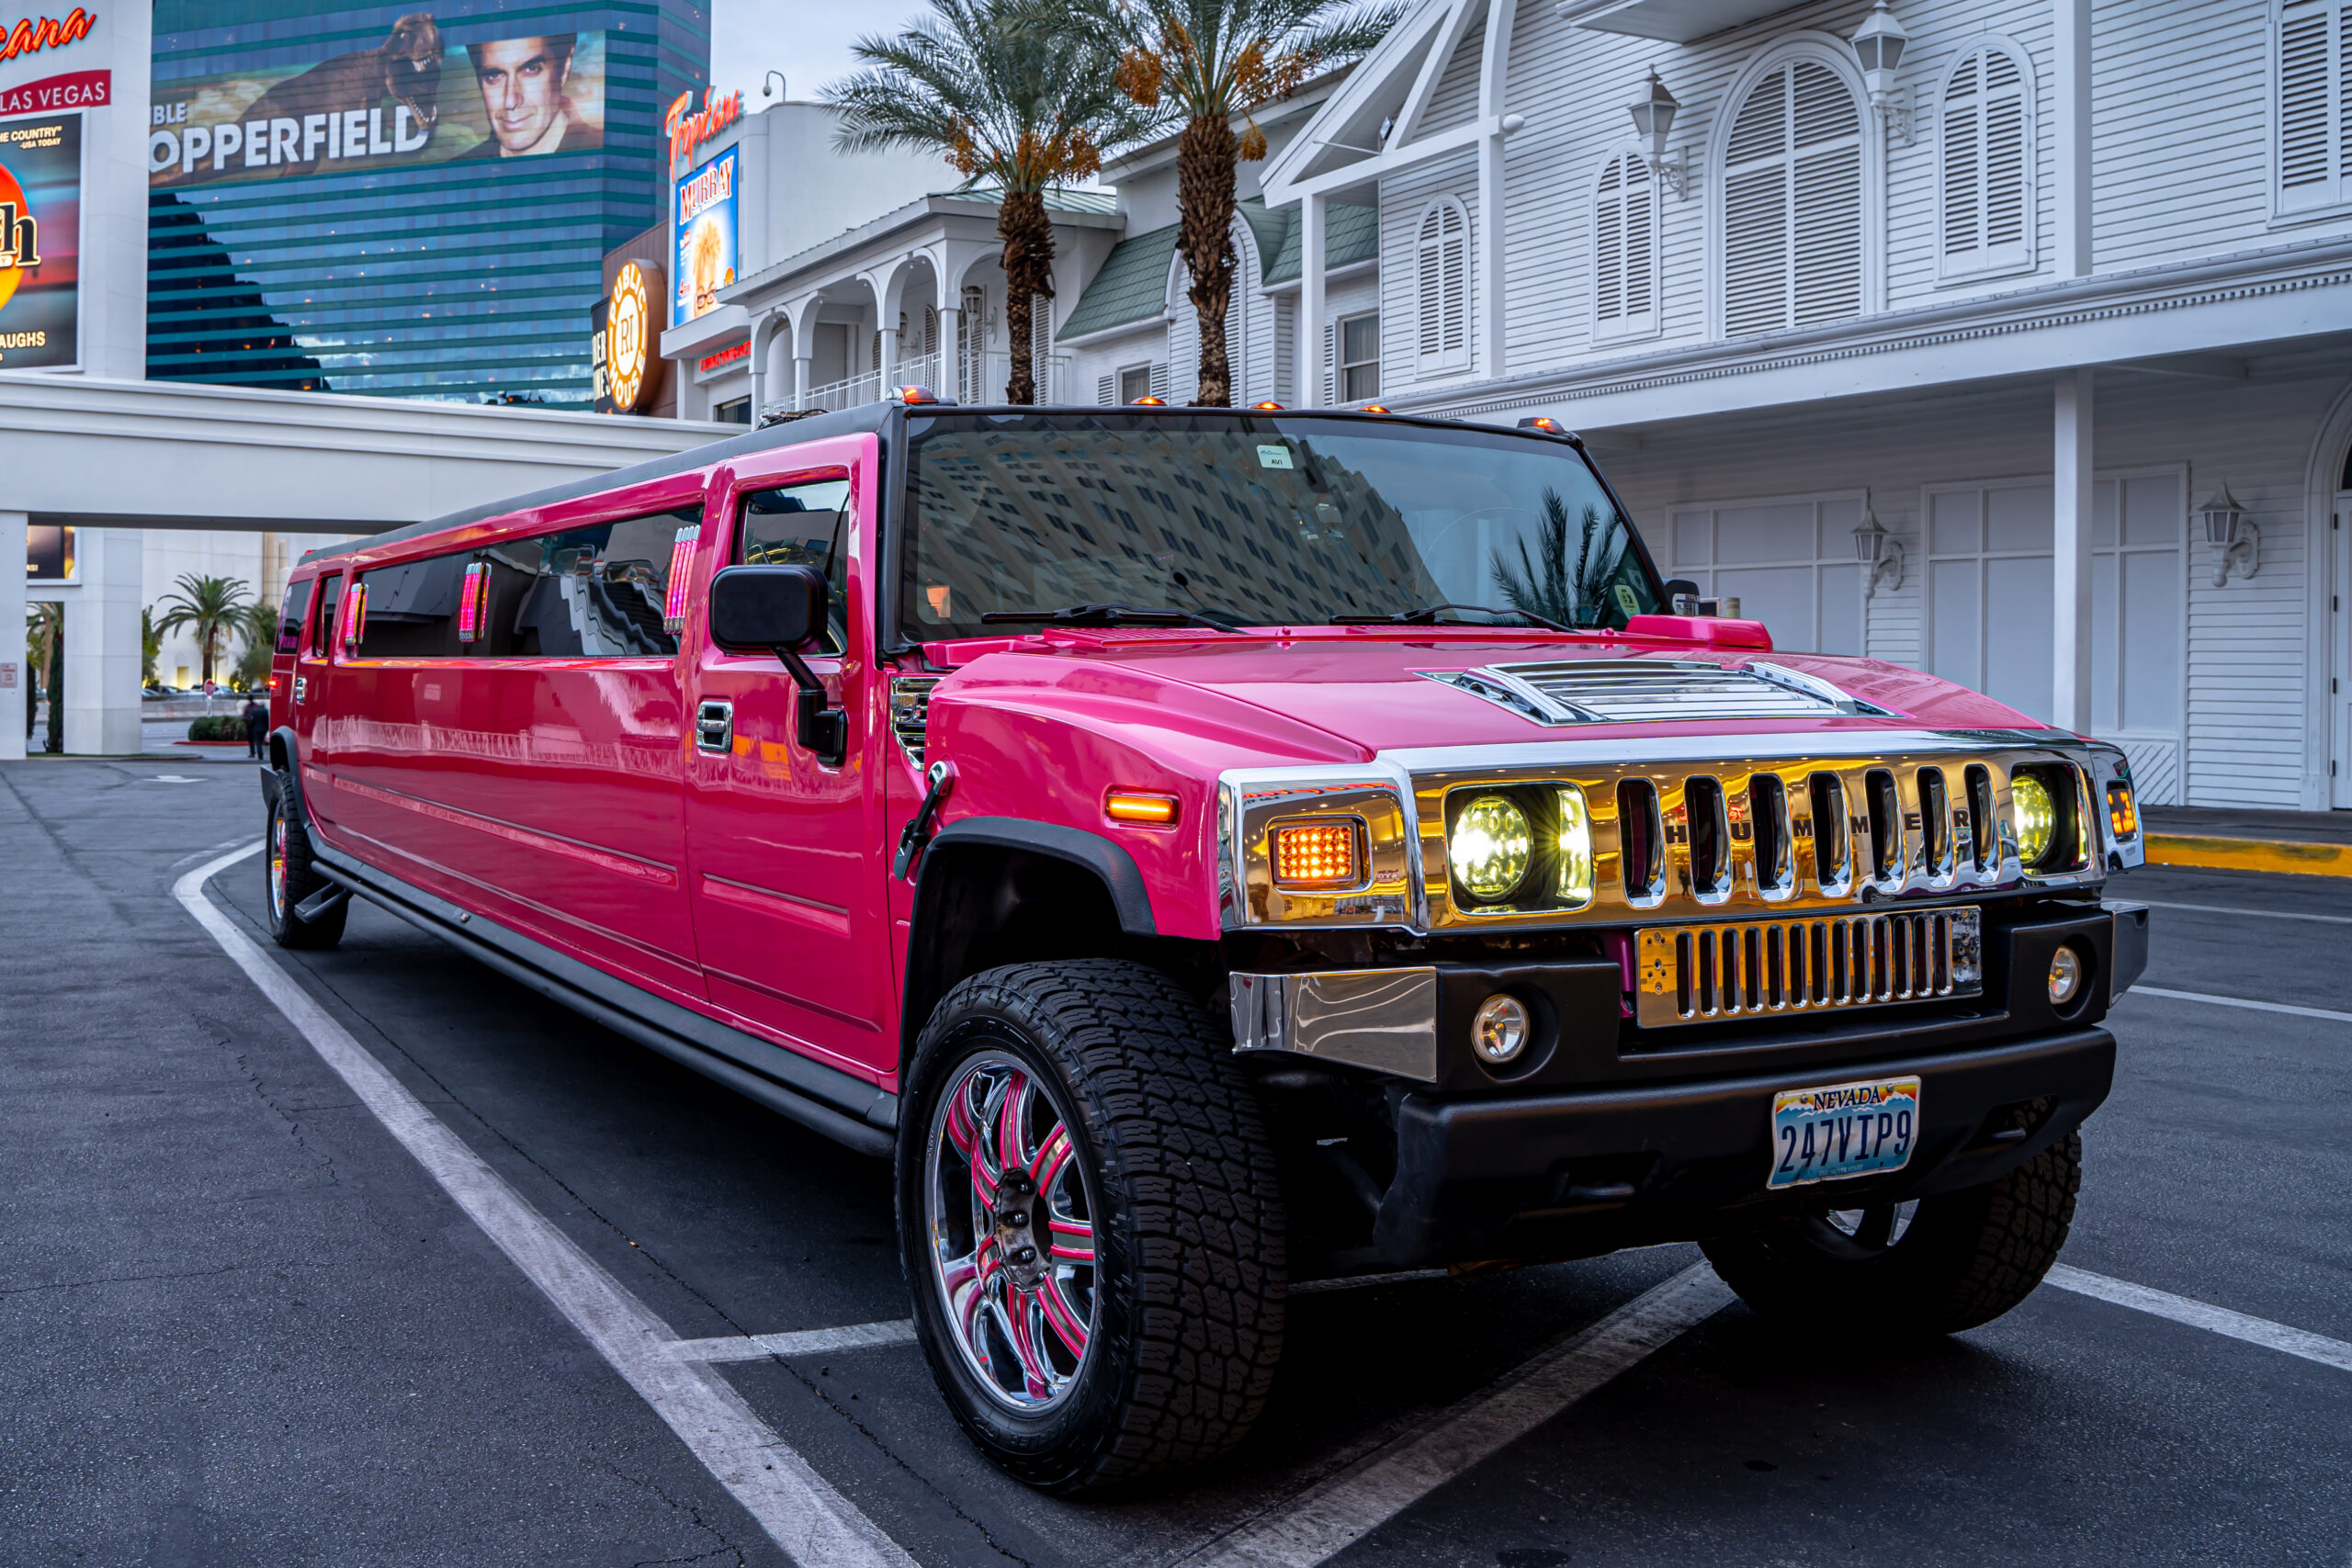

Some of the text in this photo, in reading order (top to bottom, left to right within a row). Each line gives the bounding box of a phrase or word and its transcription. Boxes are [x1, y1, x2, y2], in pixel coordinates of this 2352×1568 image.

[0, 82, 105, 112] LAS VEGAS
[149, 105, 429, 174] OPPERFIELD
[680, 155, 734, 226] MURRAY
[609, 264, 646, 326] PUBLIC
[620, 314, 634, 356] RI
[609, 349, 646, 406] HOUSE
[1664, 809, 1970, 844] HUMMER
[1813, 1086, 1882, 1111] NEVADA
[1779, 1110, 1912, 1173] 247VIP9
